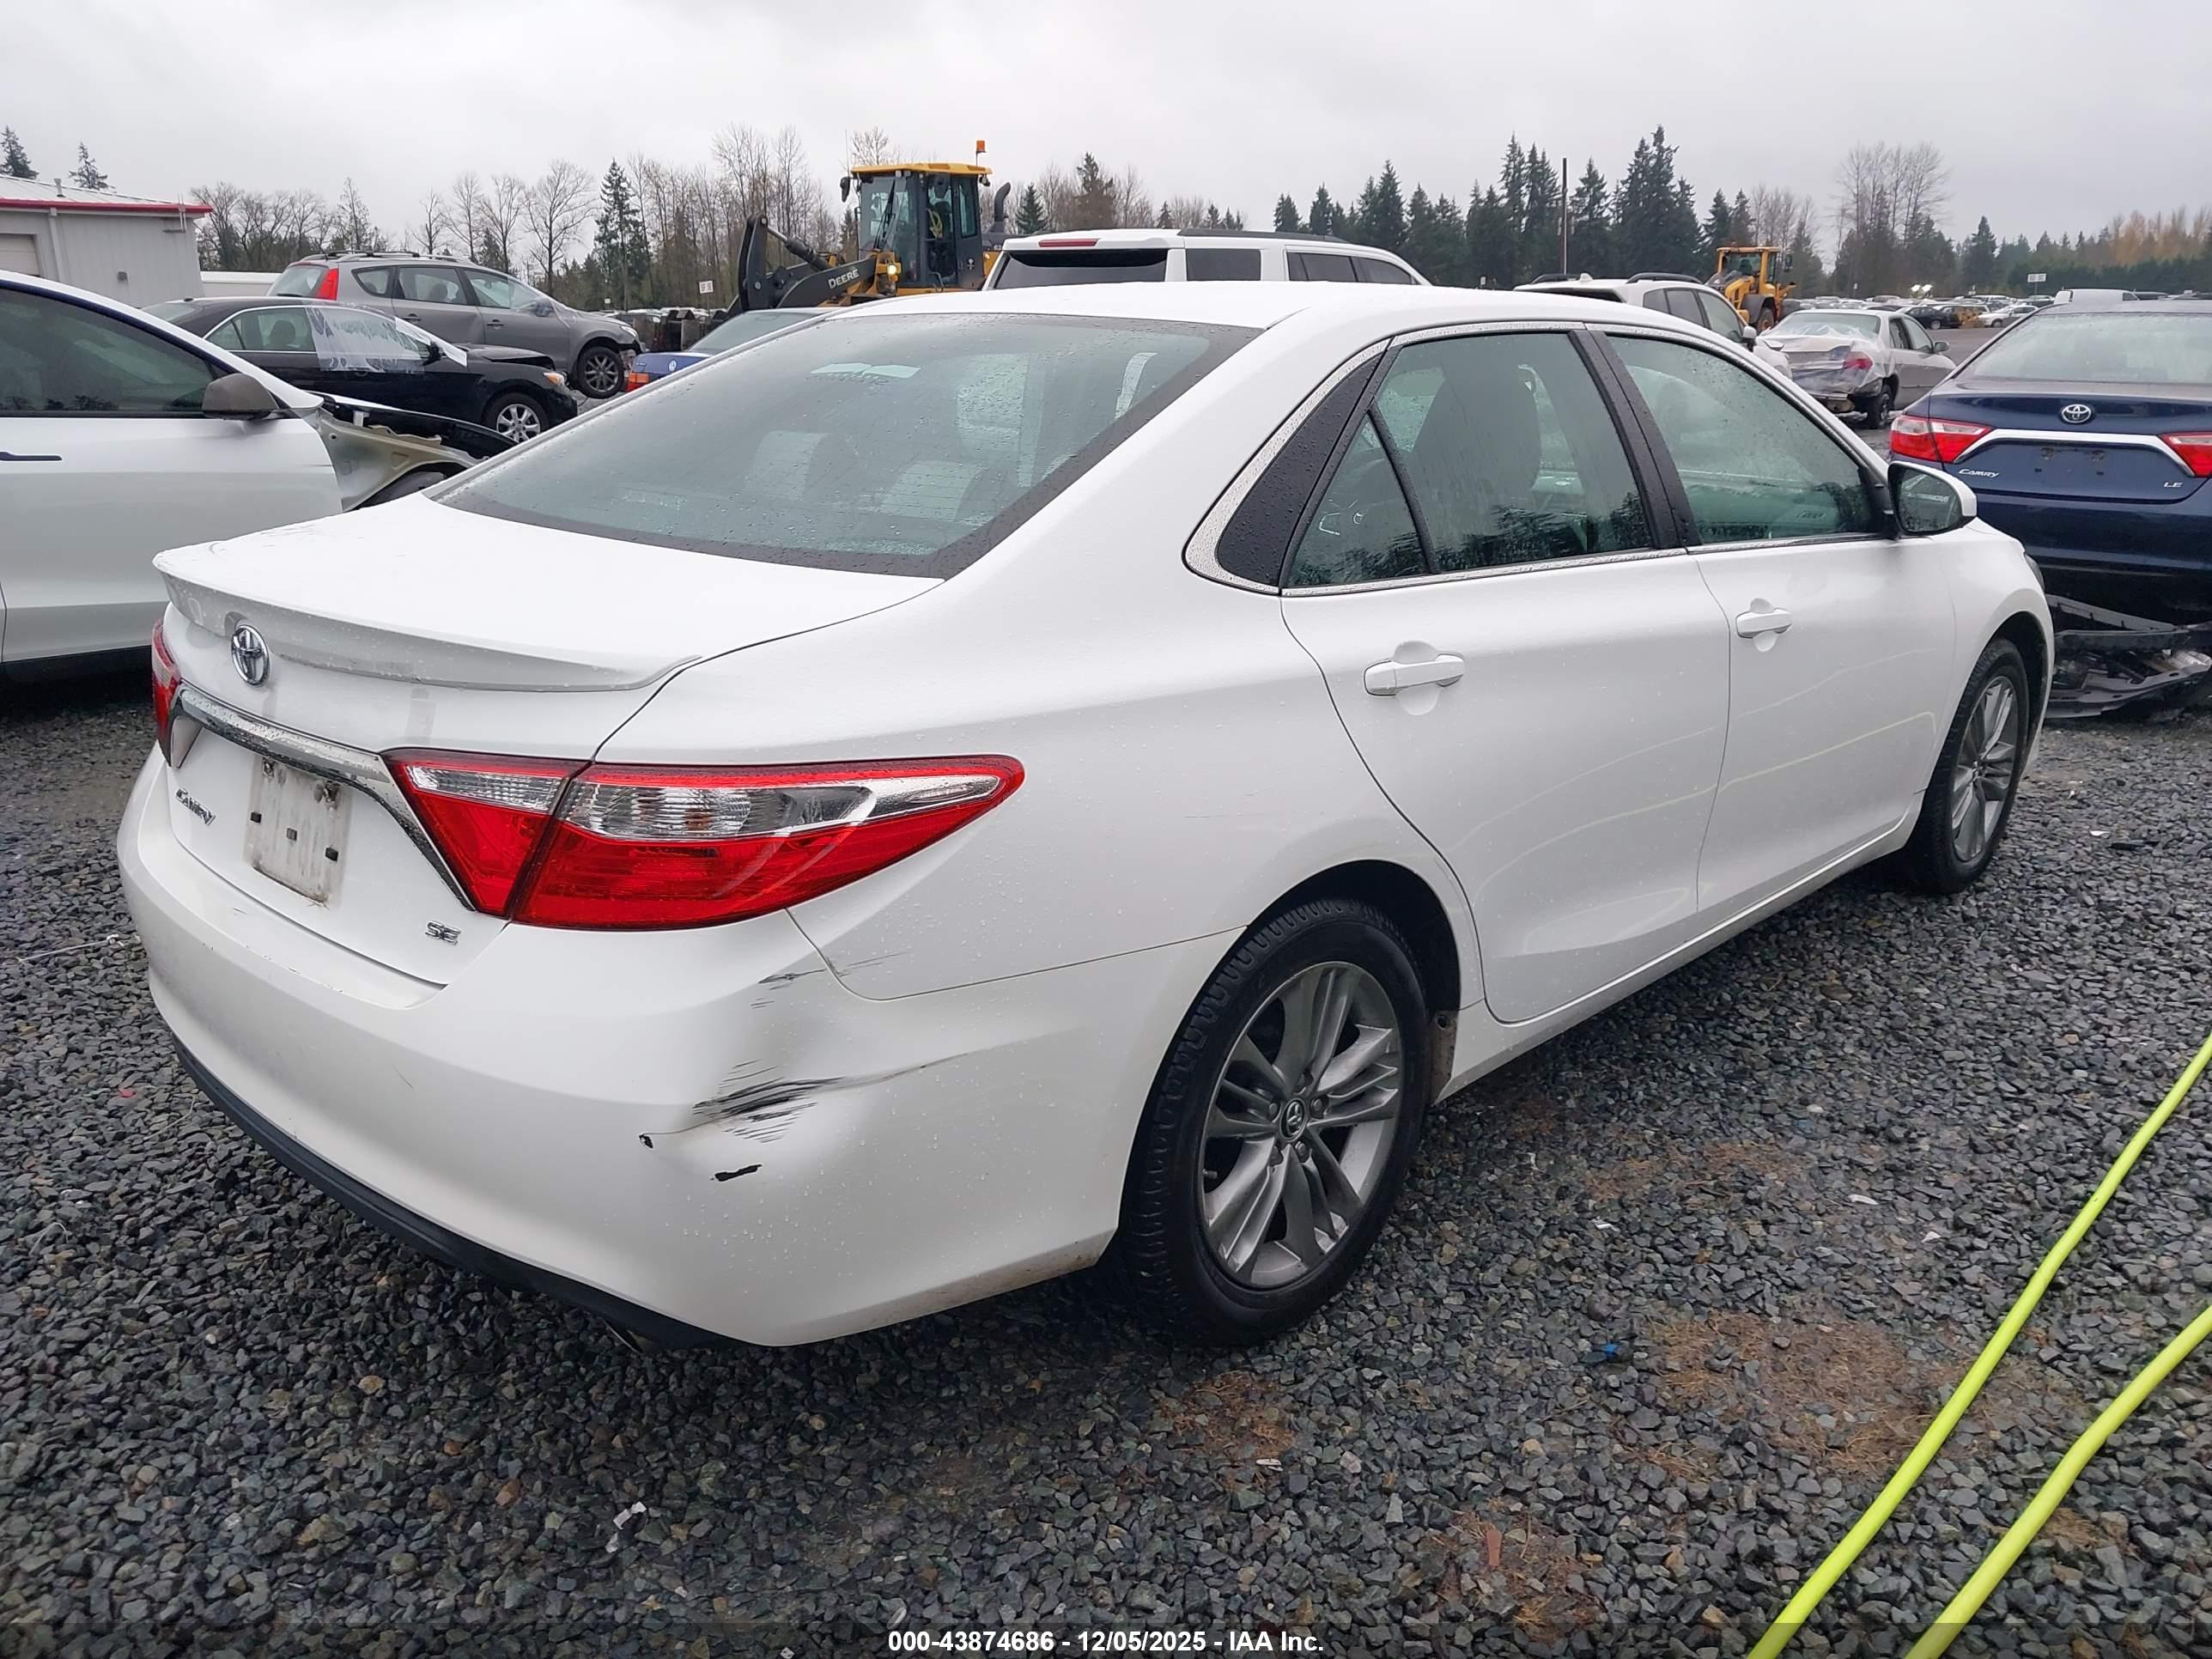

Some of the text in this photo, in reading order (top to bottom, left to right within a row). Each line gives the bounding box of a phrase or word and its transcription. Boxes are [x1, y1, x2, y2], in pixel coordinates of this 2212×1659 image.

[828, 269, 860, 289] DEERE
[1958, 469, 2000, 478] CAMRY
[175, 787, 216, 826] CAMRY
[424, 921, 461, 945] SE
